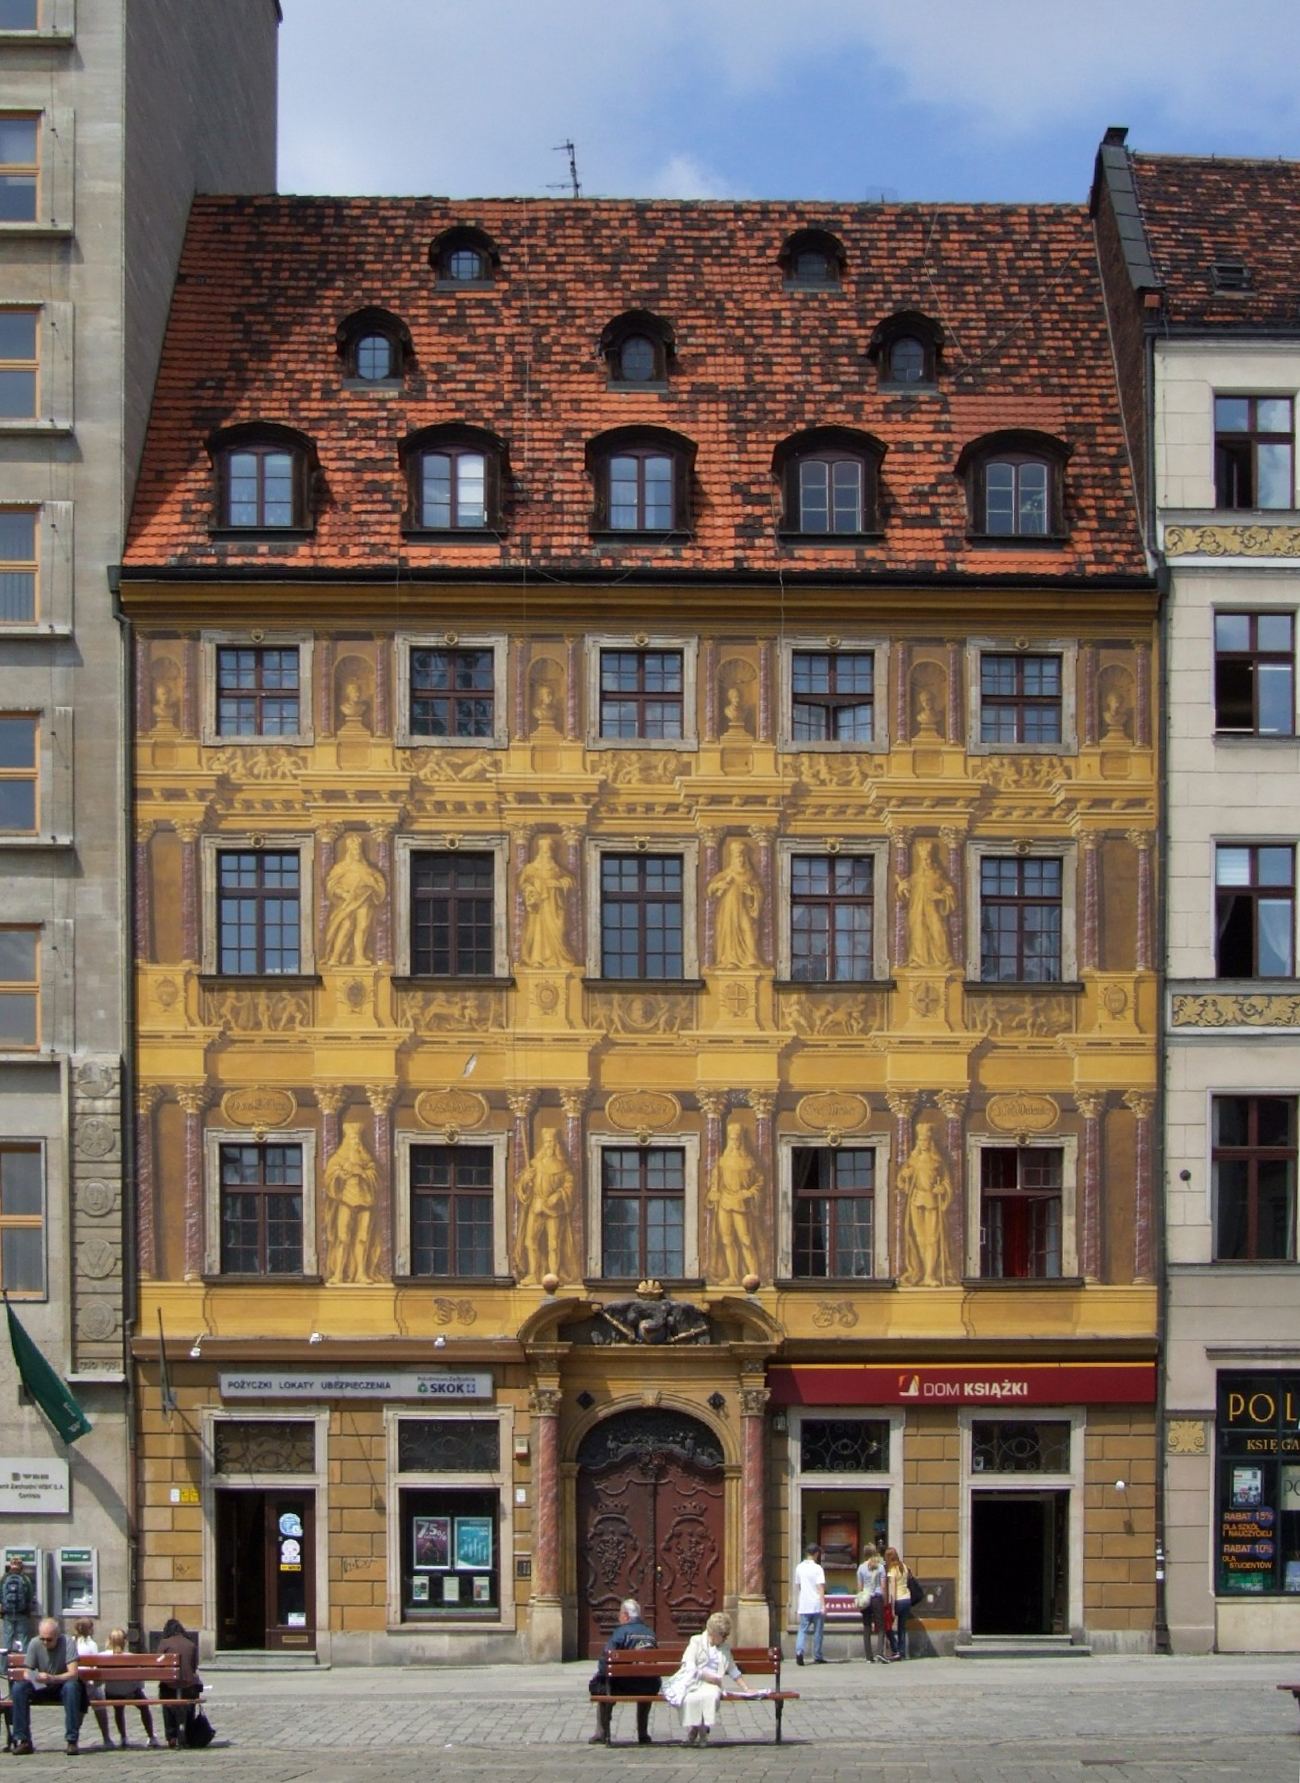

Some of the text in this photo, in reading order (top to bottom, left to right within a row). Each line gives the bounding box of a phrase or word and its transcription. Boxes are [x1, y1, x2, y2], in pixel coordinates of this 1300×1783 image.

[227, 1379, 392, 1390] POŻYCZKI LOKATY UBEZPIECZENIA
[430, 1383, 465, 1394] SKOK
[923, 1379, 1028, 1398] DOM KSIĄŻKI
[1224, 1511, 1273, 1521] RABAT 15%
[1223, 1544, 1273, 1553] RABAT 10%
